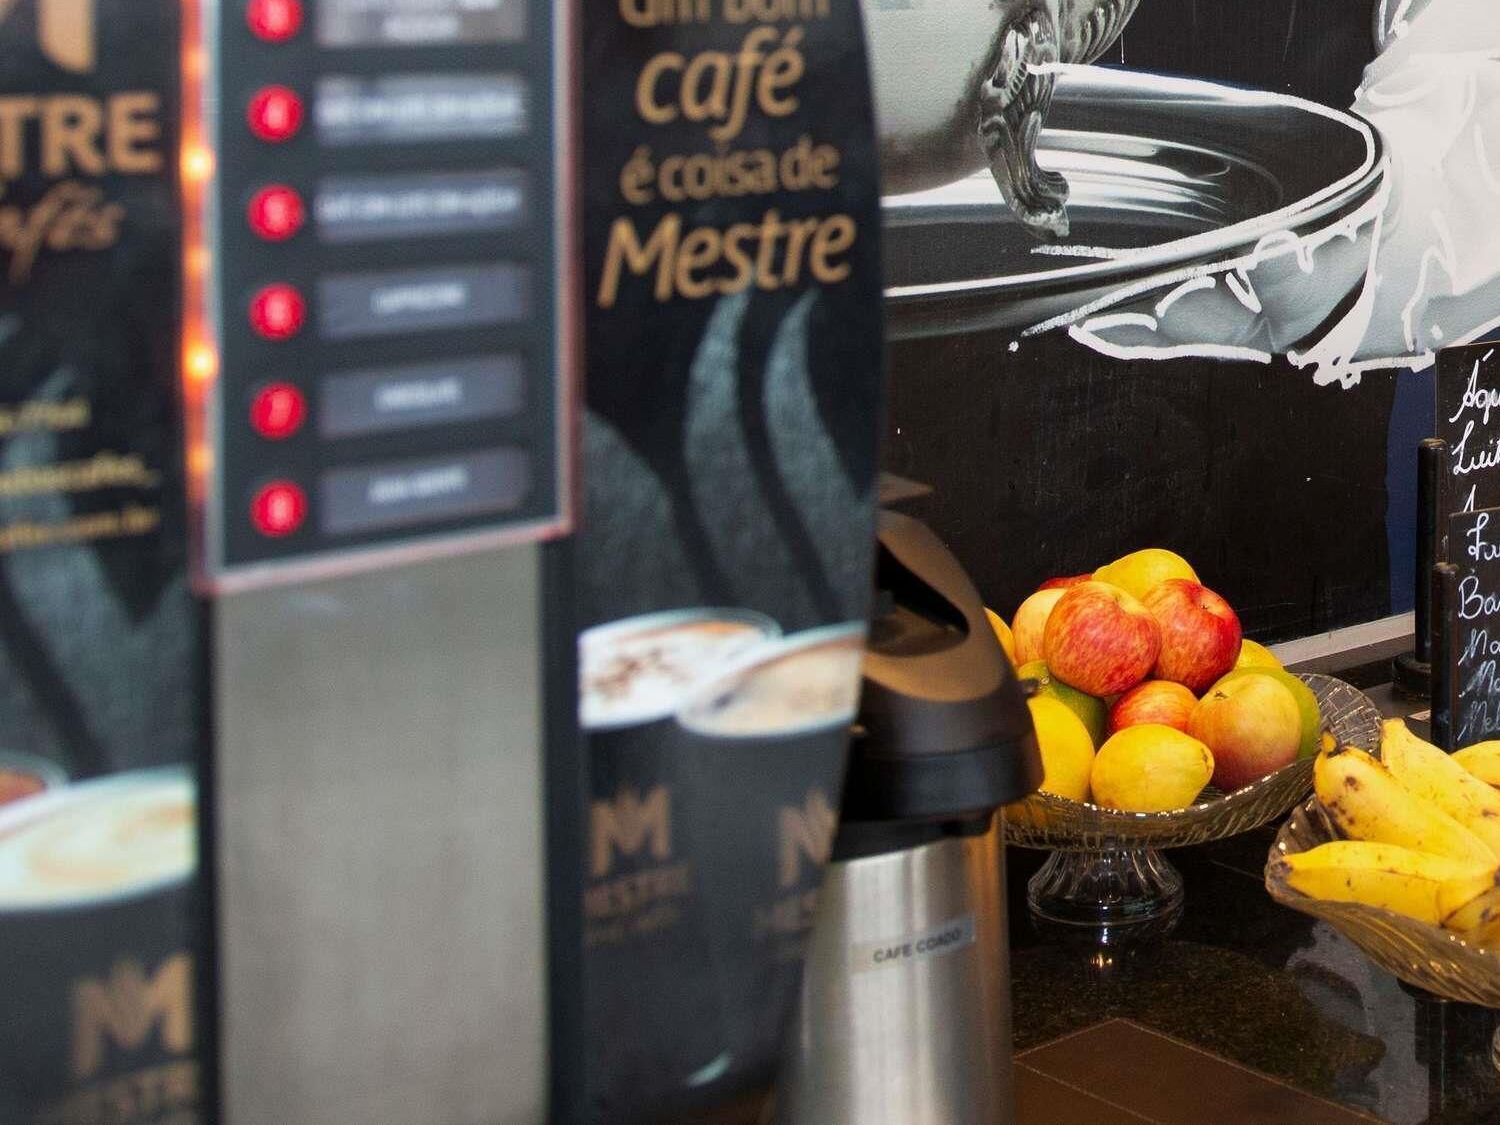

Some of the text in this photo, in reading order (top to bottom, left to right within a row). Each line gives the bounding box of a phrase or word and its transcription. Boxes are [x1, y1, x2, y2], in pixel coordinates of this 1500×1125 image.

[636, 26, 805, 141] café
[619, 134, 840, 206] é coisa de
[597, 208, 857, 309] Mestre
